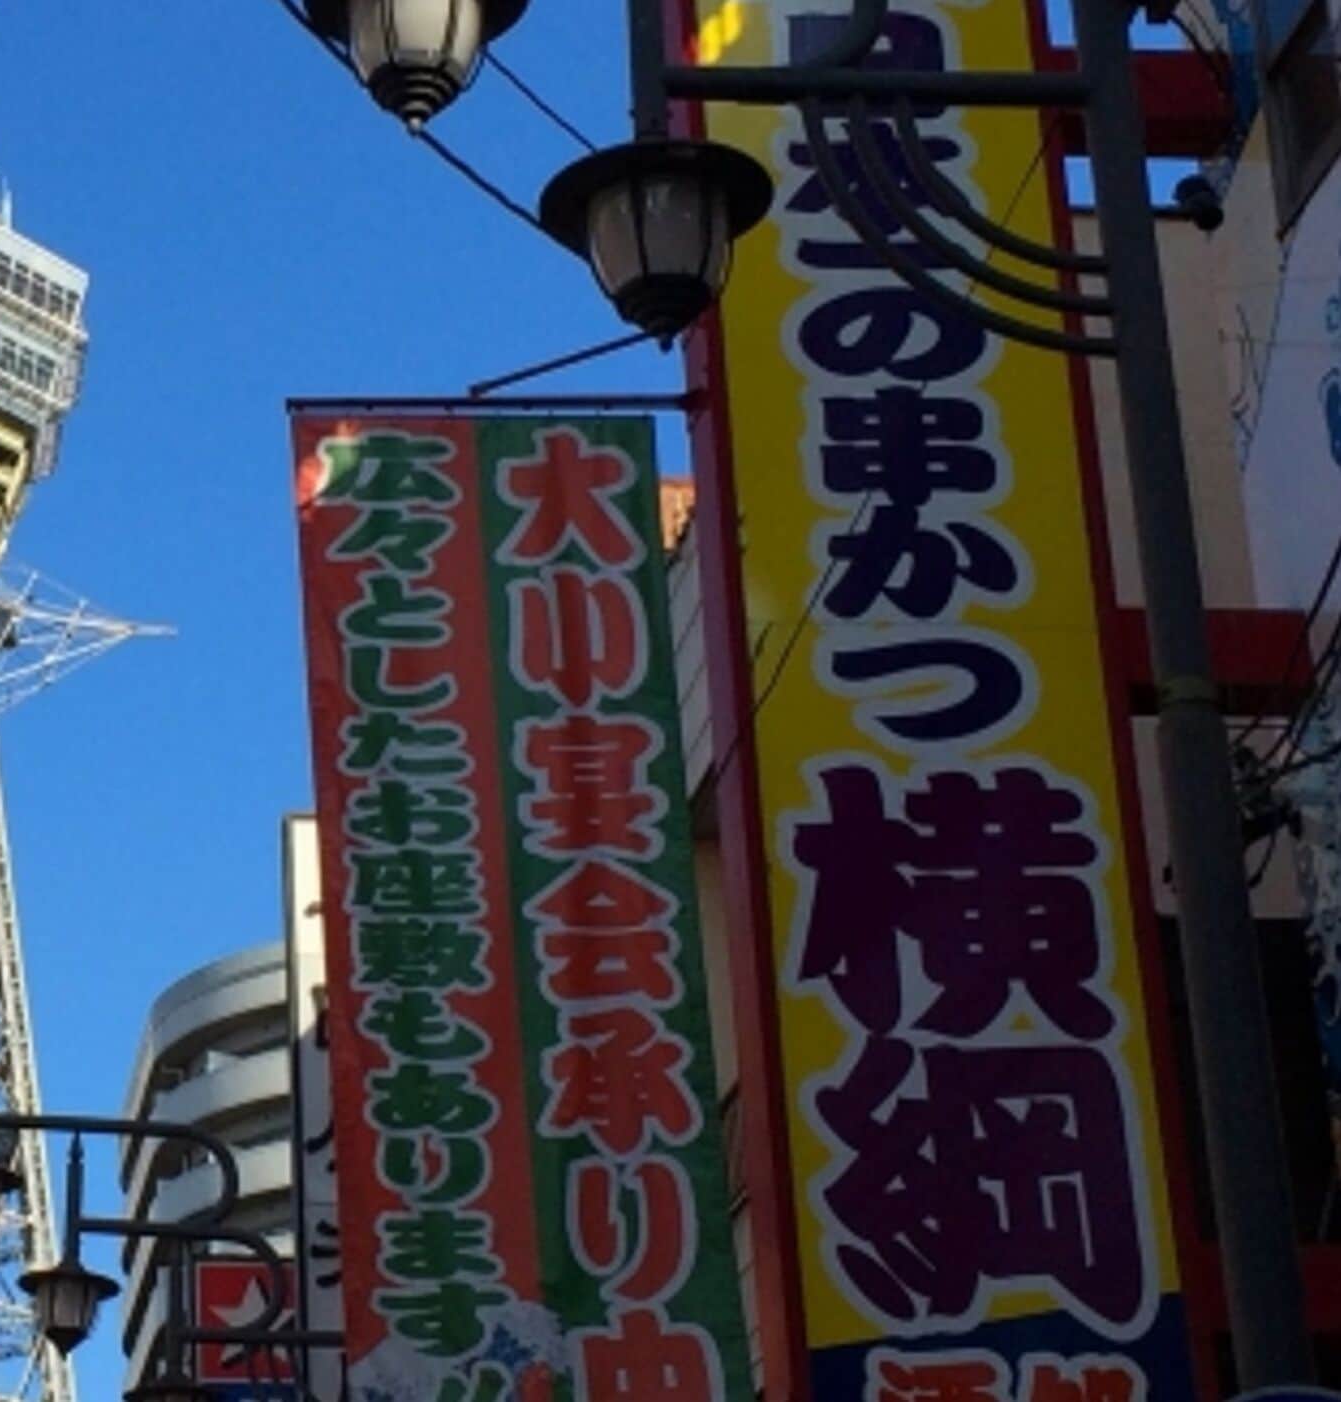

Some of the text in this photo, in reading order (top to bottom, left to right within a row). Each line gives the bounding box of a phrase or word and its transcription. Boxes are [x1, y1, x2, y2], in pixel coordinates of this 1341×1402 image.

[319, 434, 509, 1358] 広々としたお座敷もあります
[506, 430, 714, 1402] 大小宴会承り中
[793, 766, 1145, 1325] 横綱
